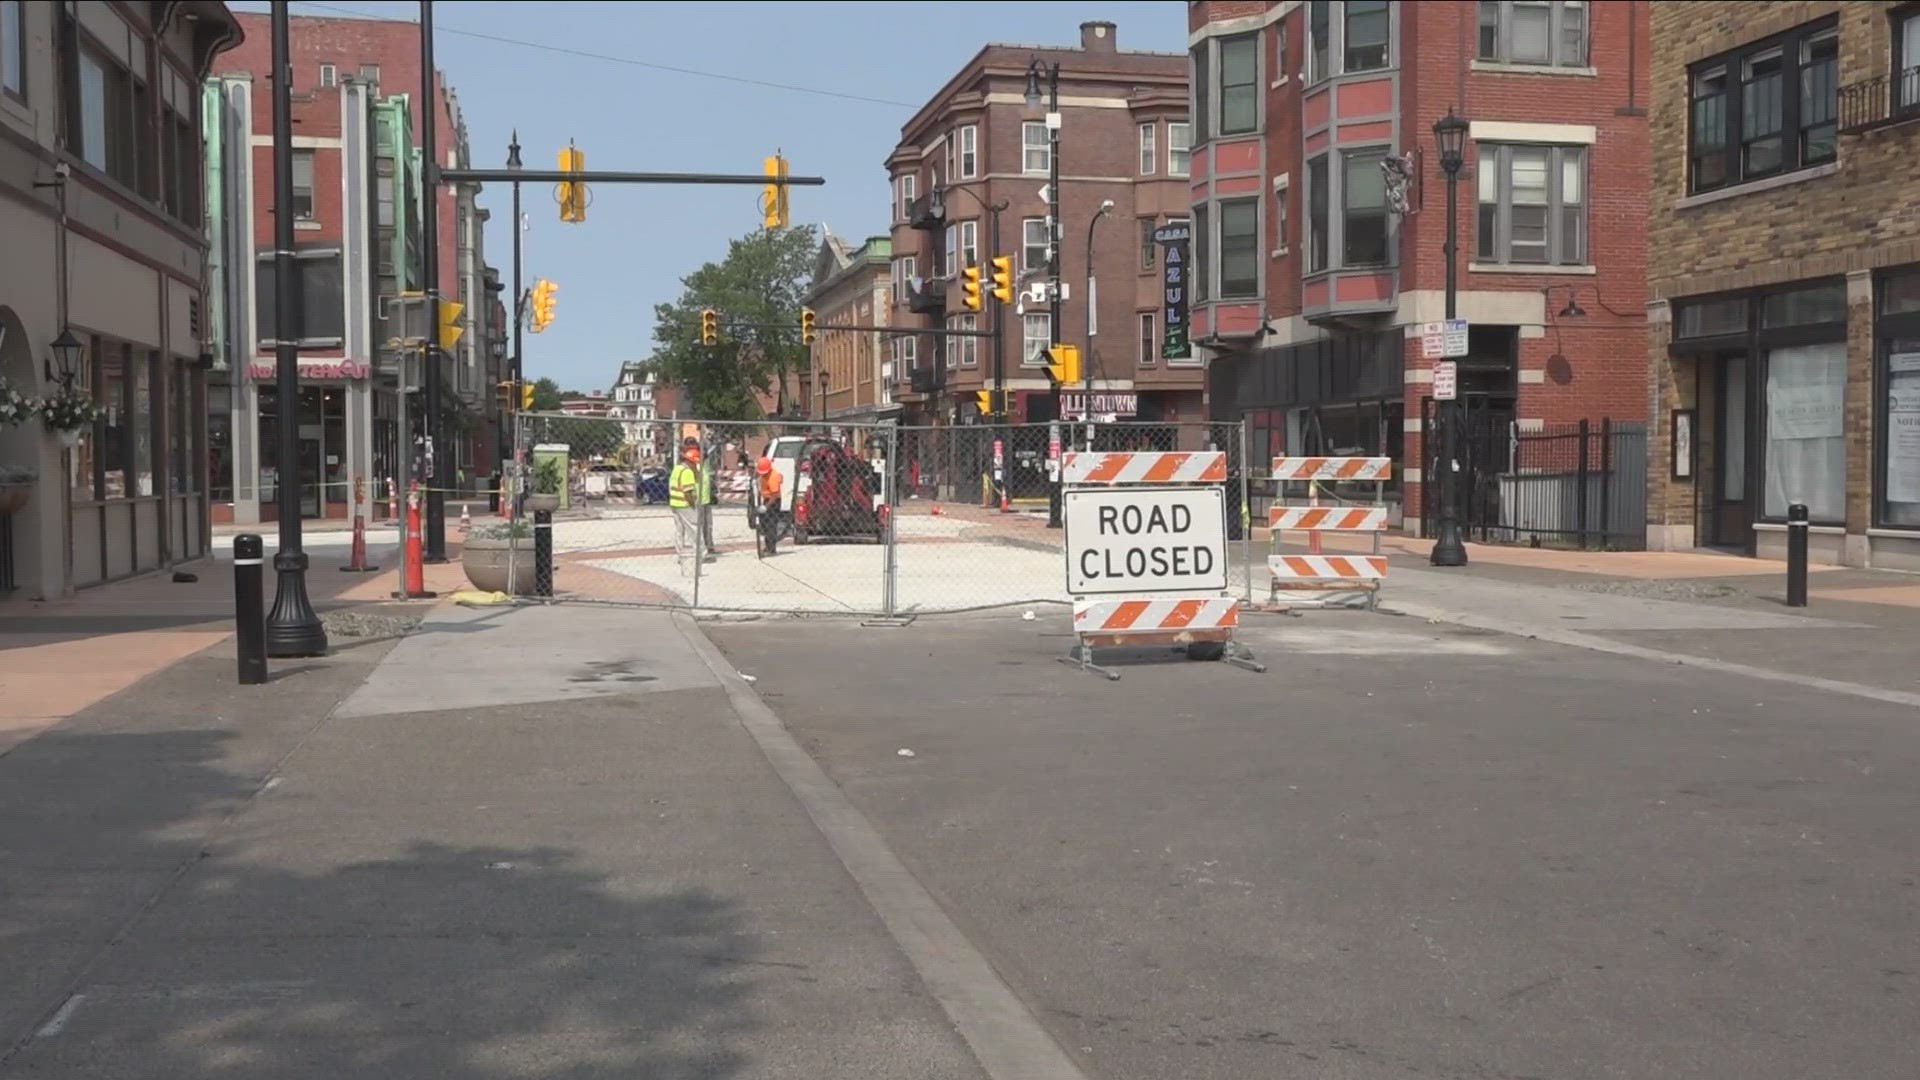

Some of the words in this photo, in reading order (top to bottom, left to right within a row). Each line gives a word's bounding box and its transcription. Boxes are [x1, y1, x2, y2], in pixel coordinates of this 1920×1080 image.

[1155, 228, 1189, 241] CASA
[1166, 247, 1182, 324] AZUL
[1098, 504, 1192, 535] ROAD
[1080, 546, 1213, 579] CLOSED
